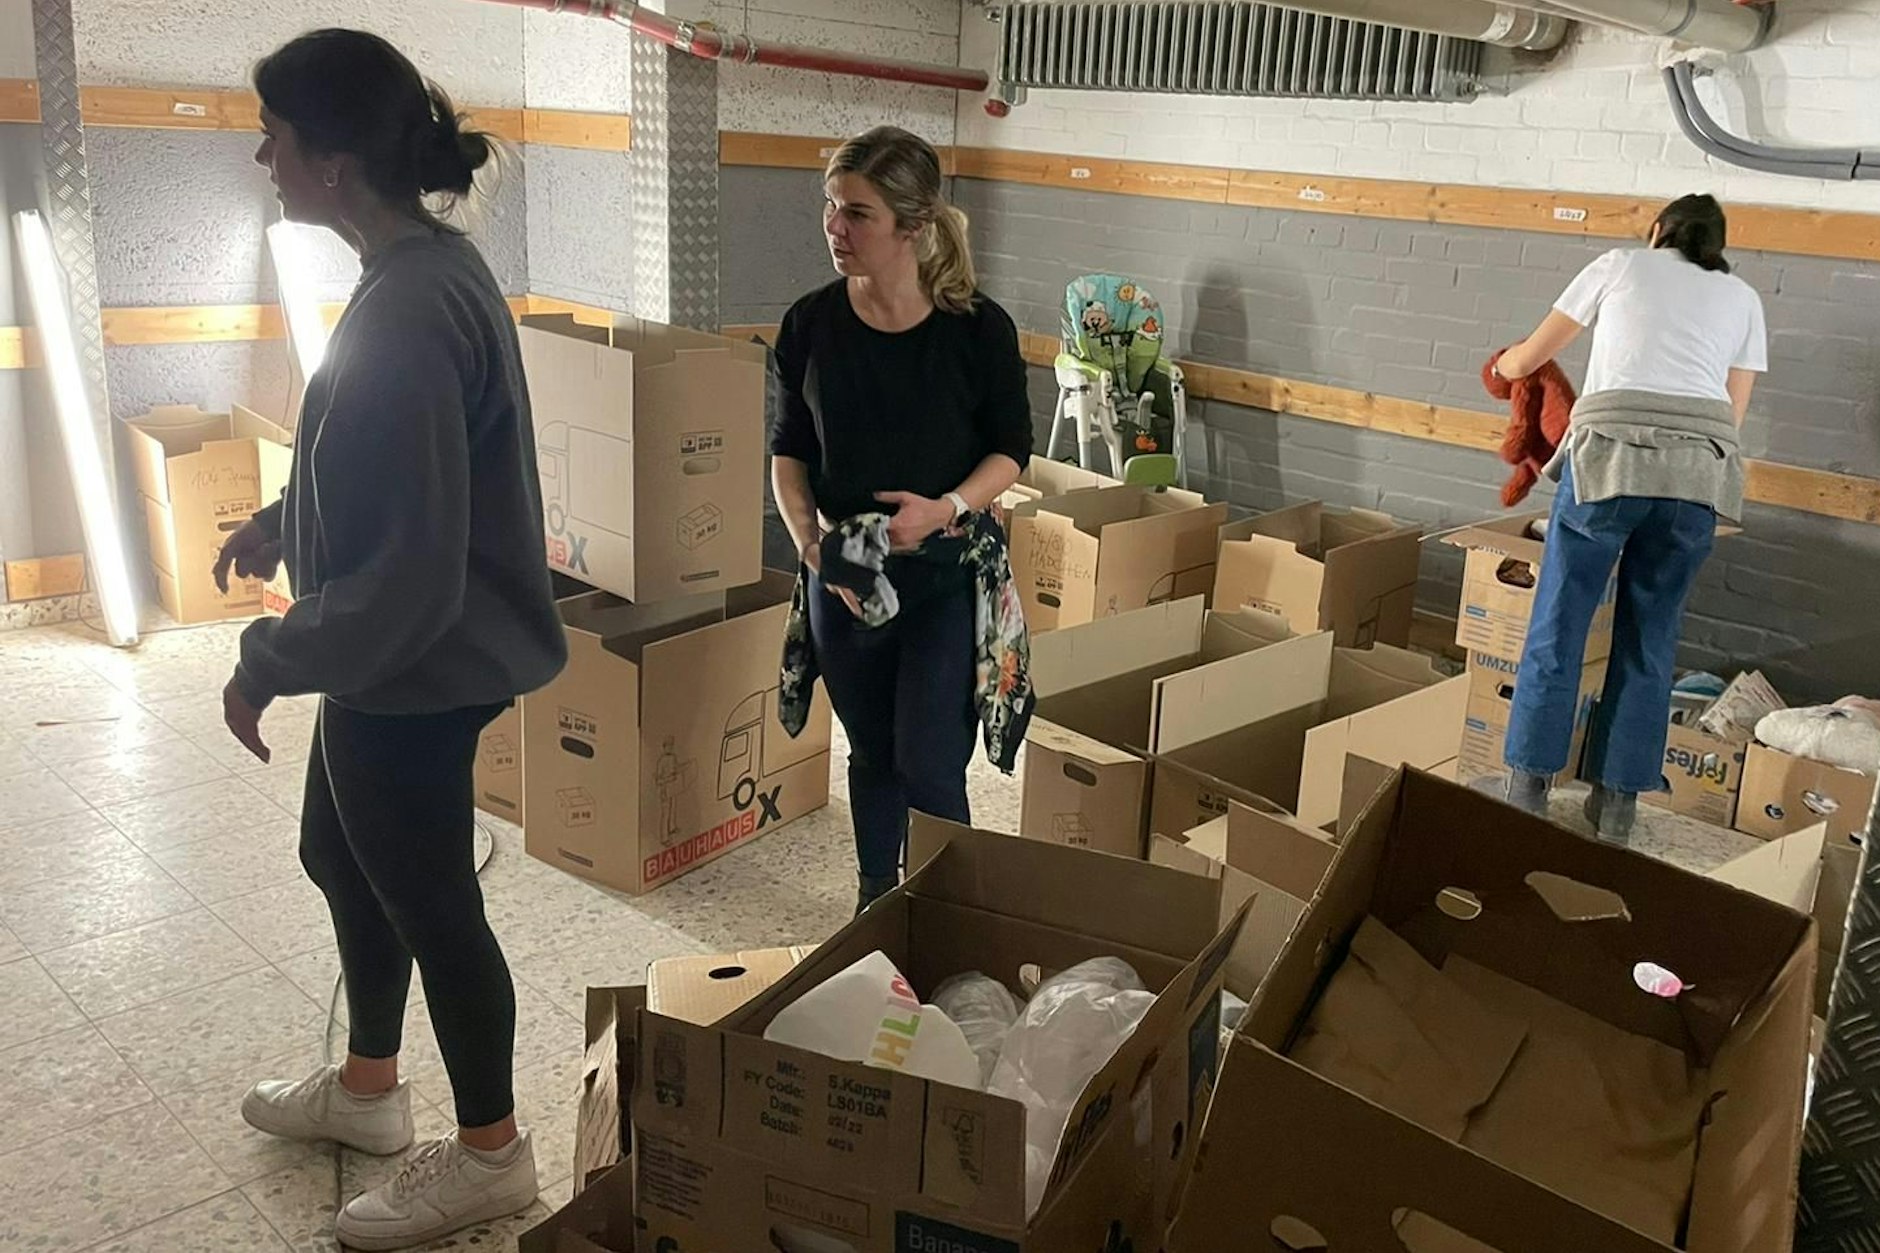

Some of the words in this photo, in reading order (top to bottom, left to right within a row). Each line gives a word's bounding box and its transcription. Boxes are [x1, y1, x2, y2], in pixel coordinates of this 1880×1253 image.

[1475, 652, 1519, 674] UMZU
[644, 811, 754, 882] BAUHAUS
[744, 1070, 763, 1085] FY
[765, 1075, 806, 1099] Code:
[828, 1075, 892, 1100] S.Kappa
[909, 1223, 988, 1253] Bana
